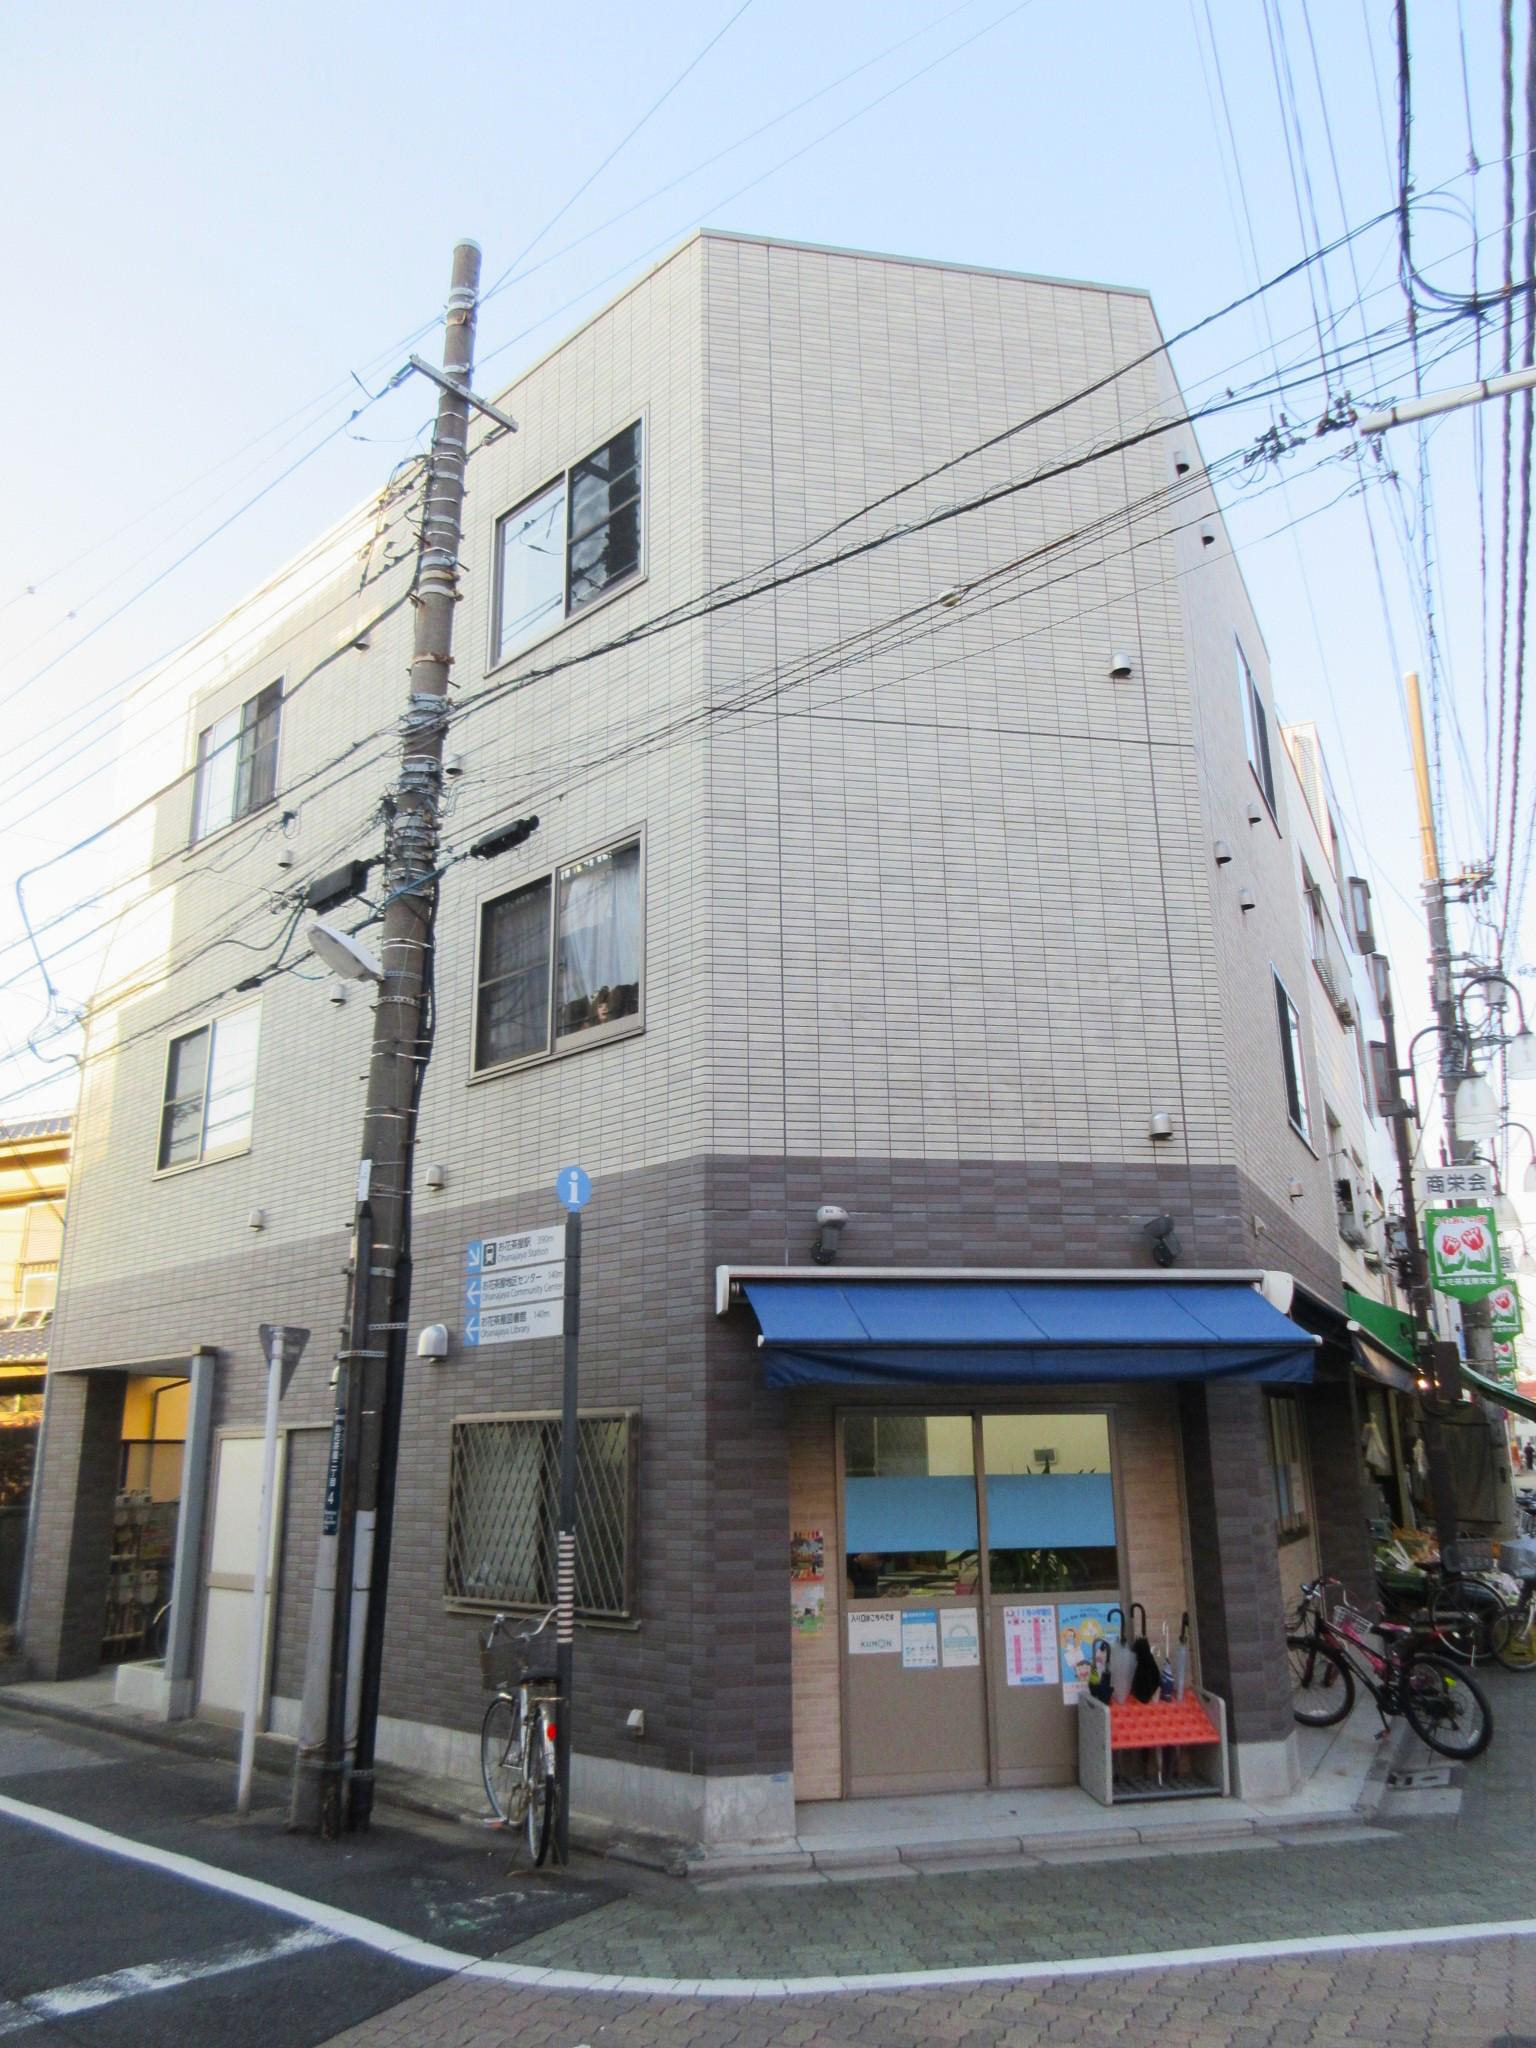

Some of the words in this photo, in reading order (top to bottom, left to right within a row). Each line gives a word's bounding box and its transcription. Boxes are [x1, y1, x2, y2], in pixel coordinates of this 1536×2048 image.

[1426, 1173, 1487, 1194] 商栄会
[498, 1236, 531, 1251] お花茶屋駅
[528, 1247, 549, 1257] Station
[482, 1273, 542, 1291] お花茶屋地区センター
[511, 1285, 543, 1298] Community
[544, 1282, 563, 1293] Center
[481, 1311, 527, 1327] お花茶屋図書館
[511, 1325, 531, 1336] Library
[327, 1491, 334, 1505] 4
